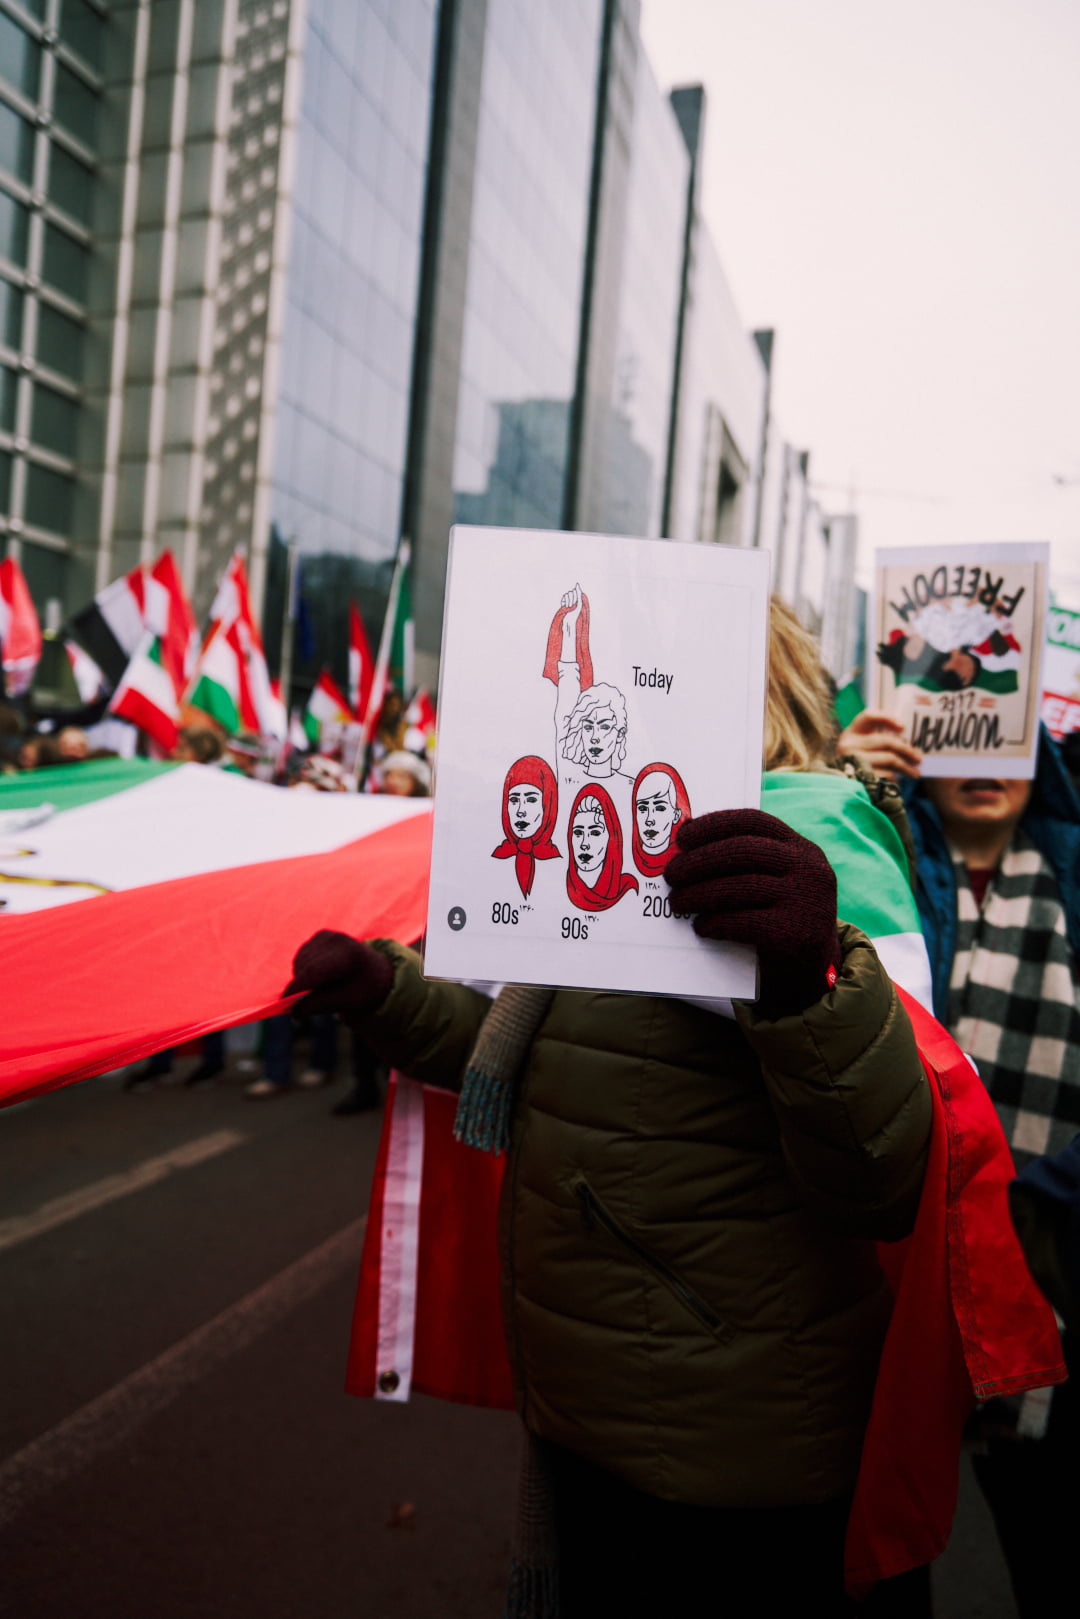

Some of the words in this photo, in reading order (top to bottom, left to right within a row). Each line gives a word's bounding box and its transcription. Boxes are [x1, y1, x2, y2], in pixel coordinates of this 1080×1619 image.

[889, 565, 1025, 622] FREEDOM
[632, 666, 673, 695] Today
[492, 902, 519, 925] 80s
[643, 895, 691, 920] 200
[561, 917, 588, 940] 90s
